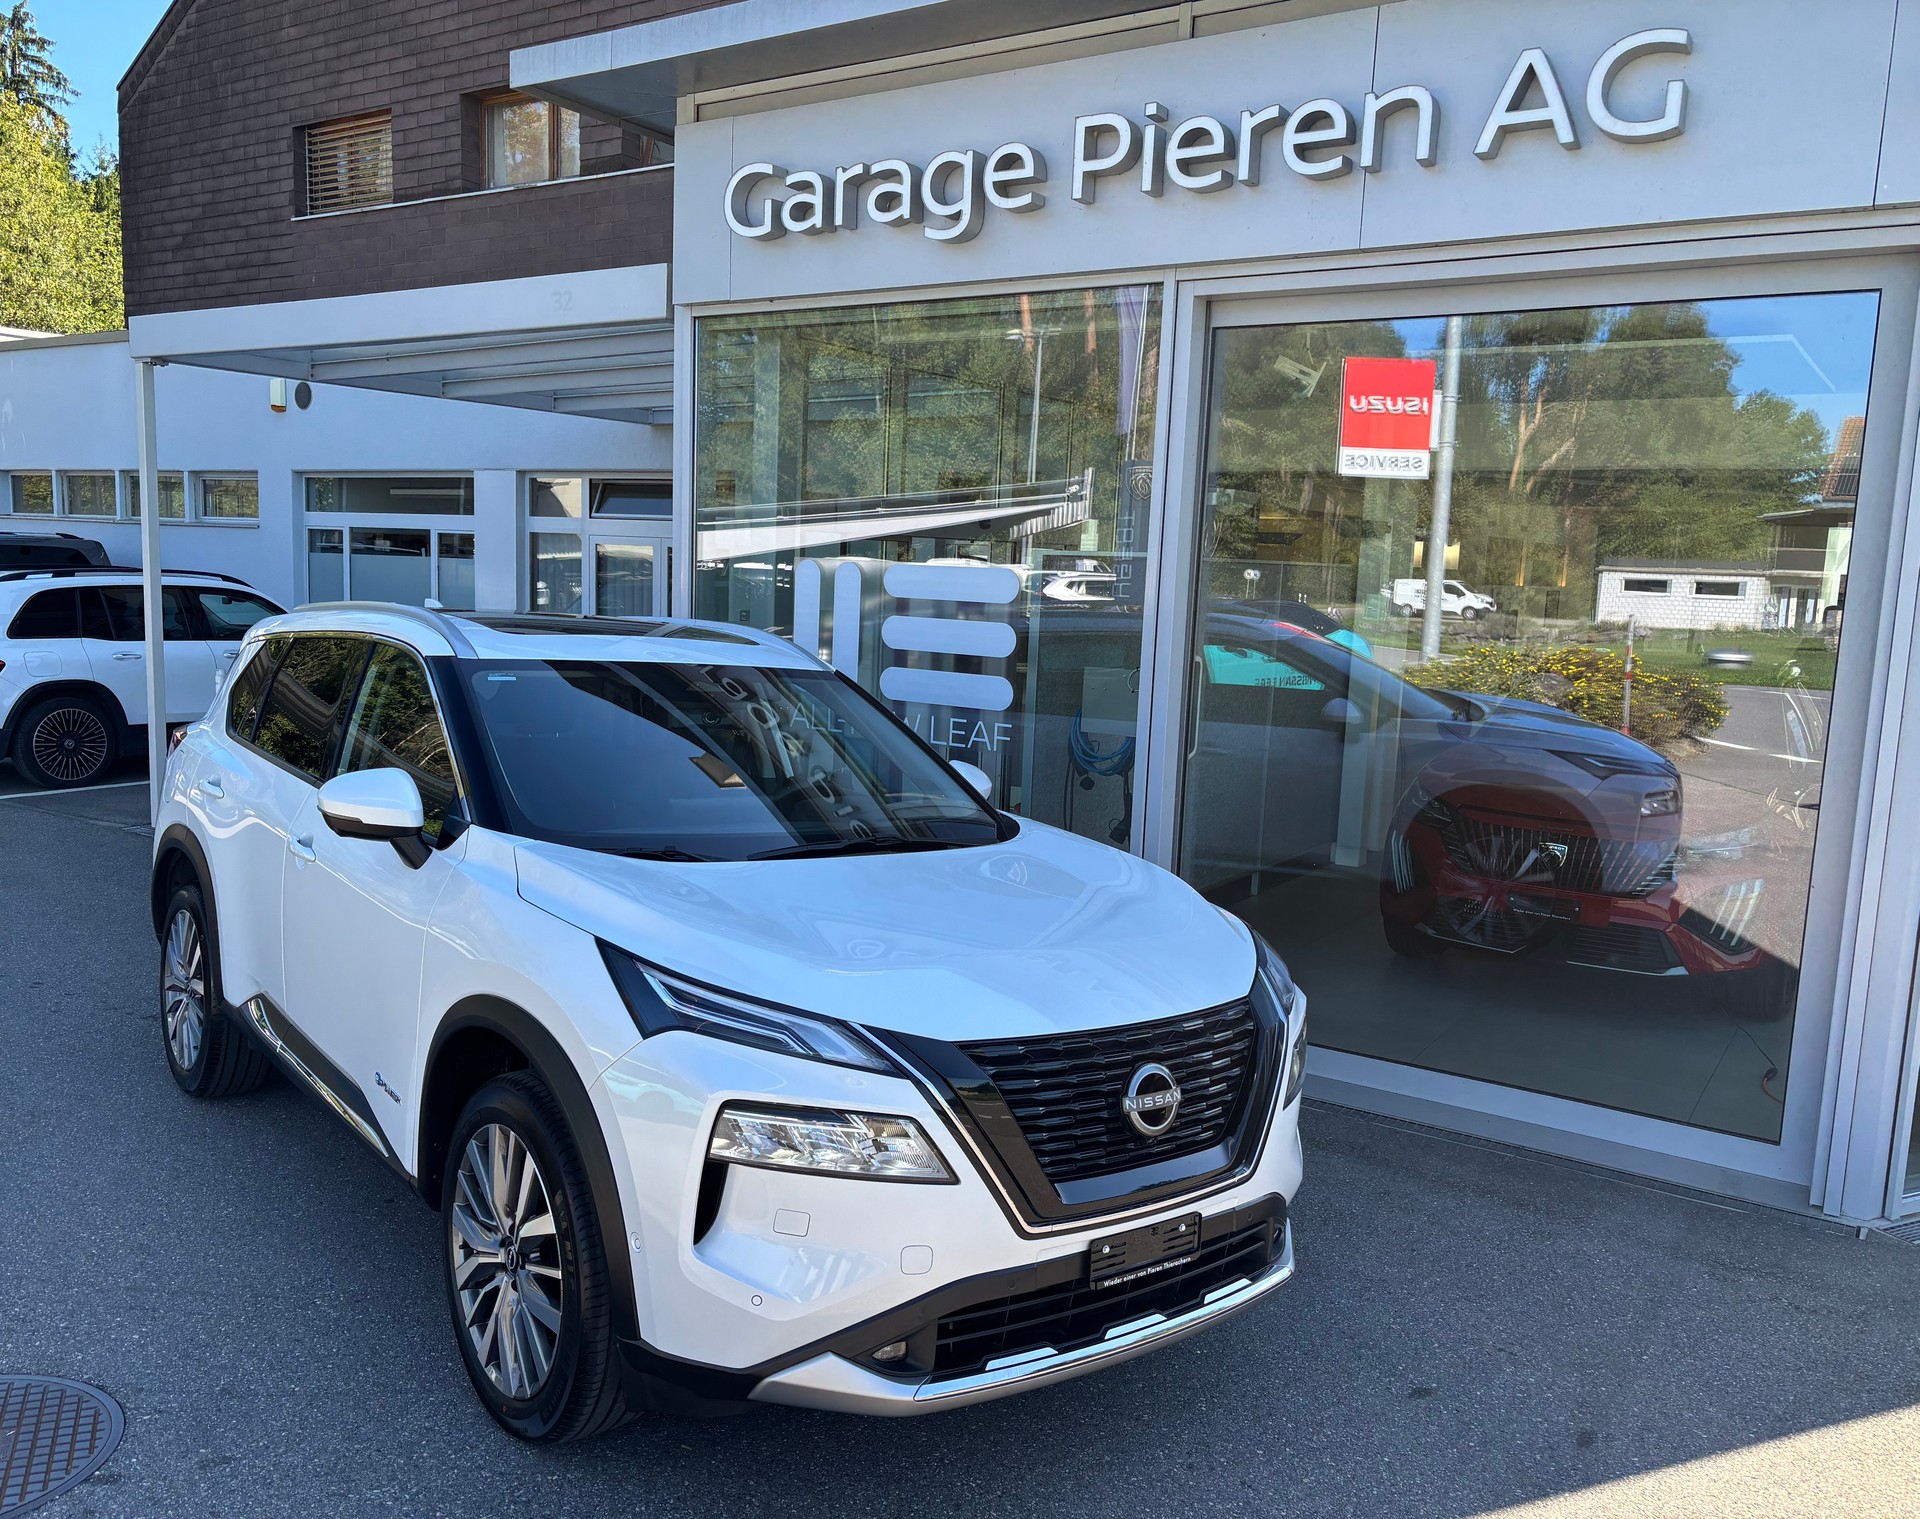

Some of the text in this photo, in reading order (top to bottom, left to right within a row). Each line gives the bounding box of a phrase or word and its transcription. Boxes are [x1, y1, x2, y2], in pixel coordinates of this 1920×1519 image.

[723, 27, 1693, 244] Garage Pieren AG
[551, 290, 573, 313] 32
[929, 715, 1013, 752] LEAF
[1125, 1089, 1181, 1110] NISSAN
[1103, 1277, 1123, 1288] Wieder
